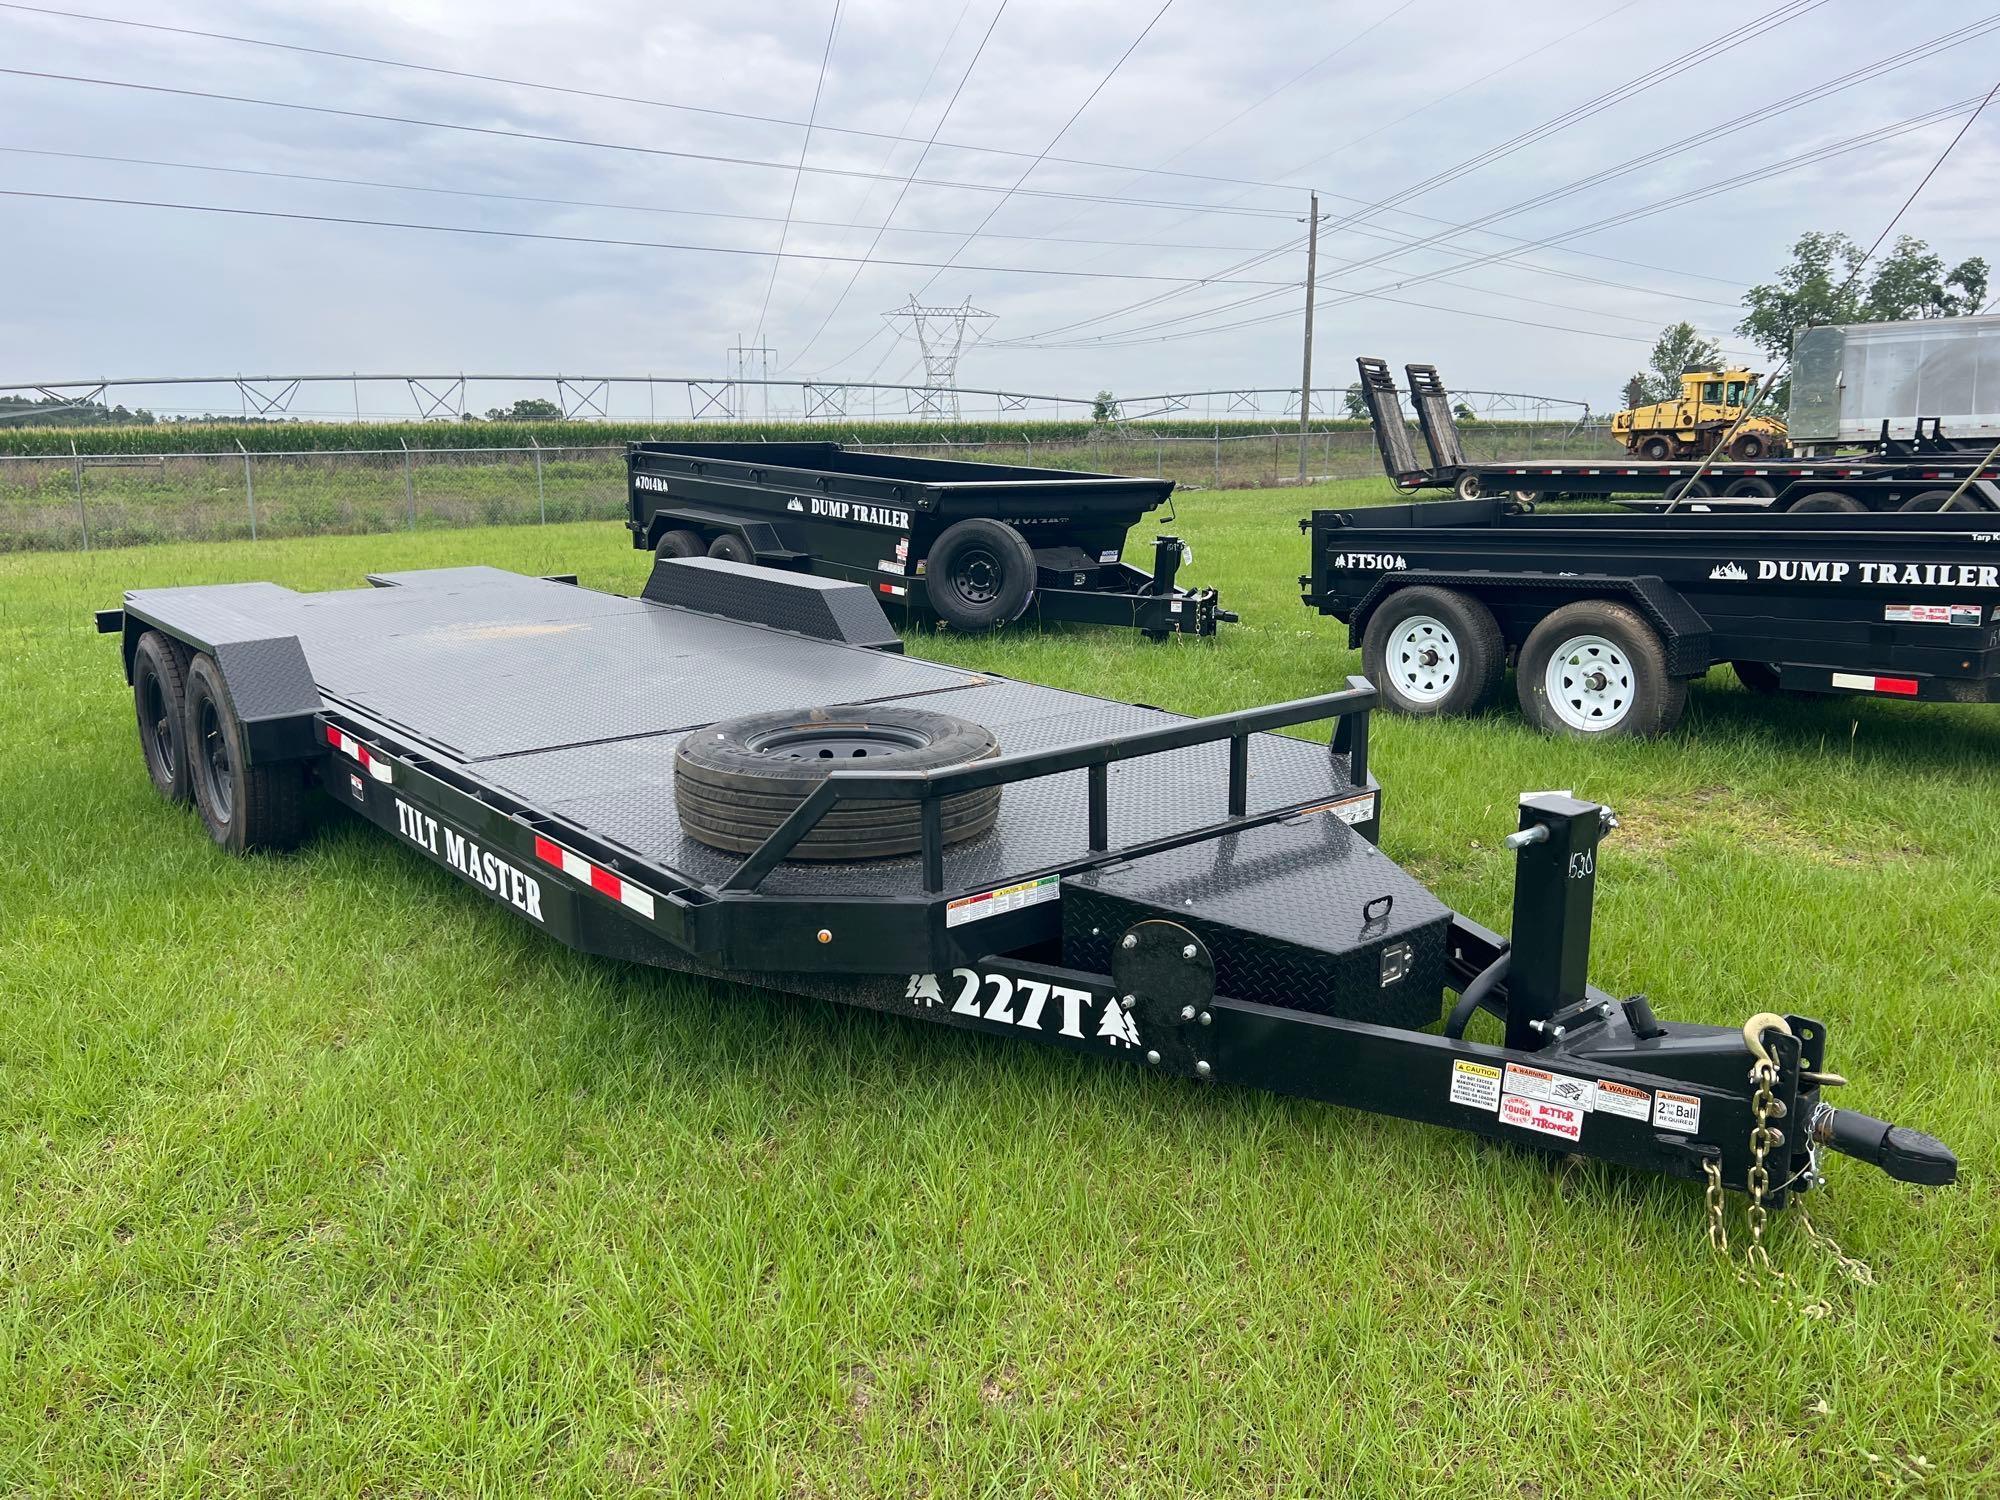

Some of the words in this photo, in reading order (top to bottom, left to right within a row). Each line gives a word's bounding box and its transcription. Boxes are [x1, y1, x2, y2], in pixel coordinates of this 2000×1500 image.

[810, 497, 850, 519] DUMP
[852, 504, 910, 530] TRAILER
[1971, 533, 1991, 543] Tarp
[1993, 533, 2000, 541] K
[1346, 553, 1395, 570] FT510
[1757, 560, 1850, 583] DUMP
[1858, 562, 2000, 588] TRAILER
[395, 797, 438, 855] TILT
[444, 826, 545, 923] MASTER
[1568, 848, 1594, 879] 1520
[951, 967, 1093, 1039] 227T
[1465, 1065, 1497, 1077] CAUTION
[1519, 1068, 1548, 1079] WARNING
[1609, 1085, 1650, 1100] WARNING
[1667, 1094, 1695, 1104] WARNING
[1504, 1103, 1531, 1117] TOUGH
[1539, 1105, 1574, 1122] BETTER
[1676, 1105, 1696, 1119] Ball
[1531, 1117, 1578, 1137] STRONGER
[1659, 1115, 1694, 1126] REQUIRED
